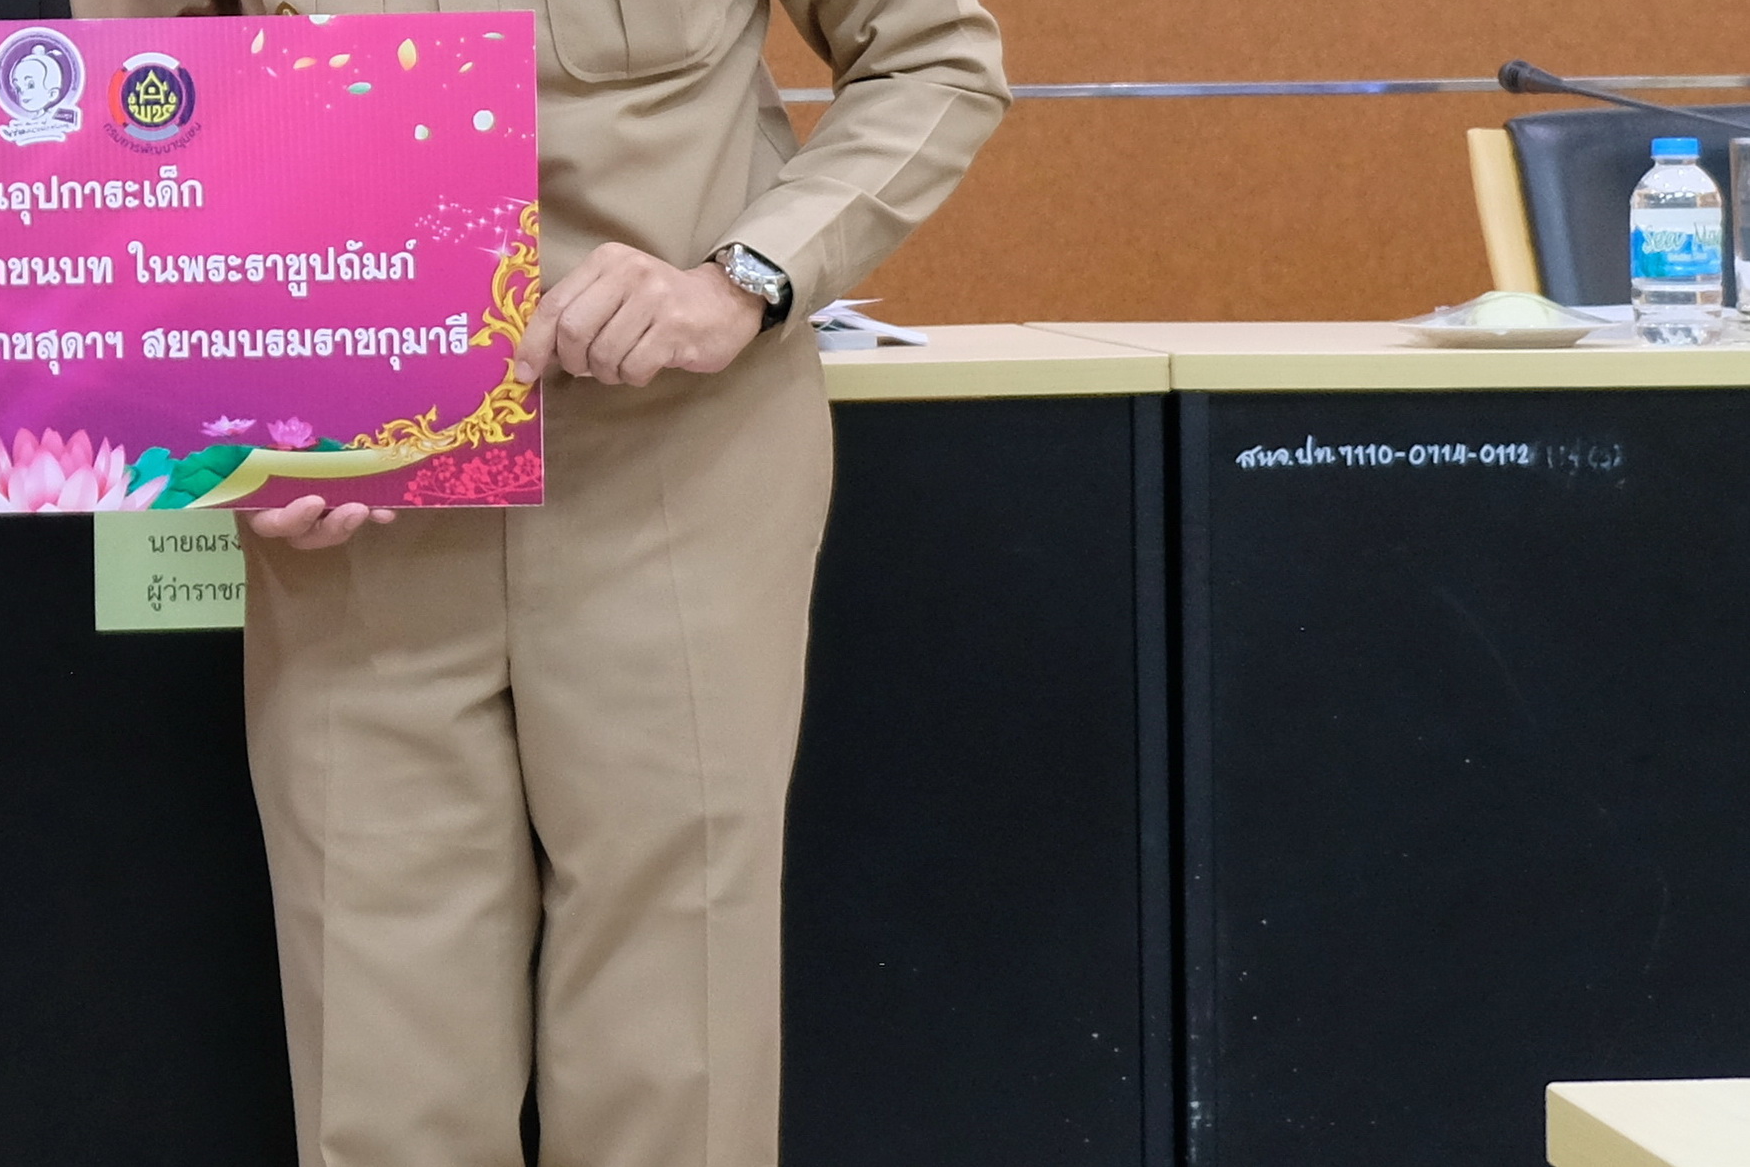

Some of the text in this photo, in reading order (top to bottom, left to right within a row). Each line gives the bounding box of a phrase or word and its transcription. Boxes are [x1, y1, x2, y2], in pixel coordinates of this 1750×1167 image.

[128, 239, 418, 298] ในพระราชูปถัมภ์
[141, 312, 469, 371] สยามบรมราชกุมารี
